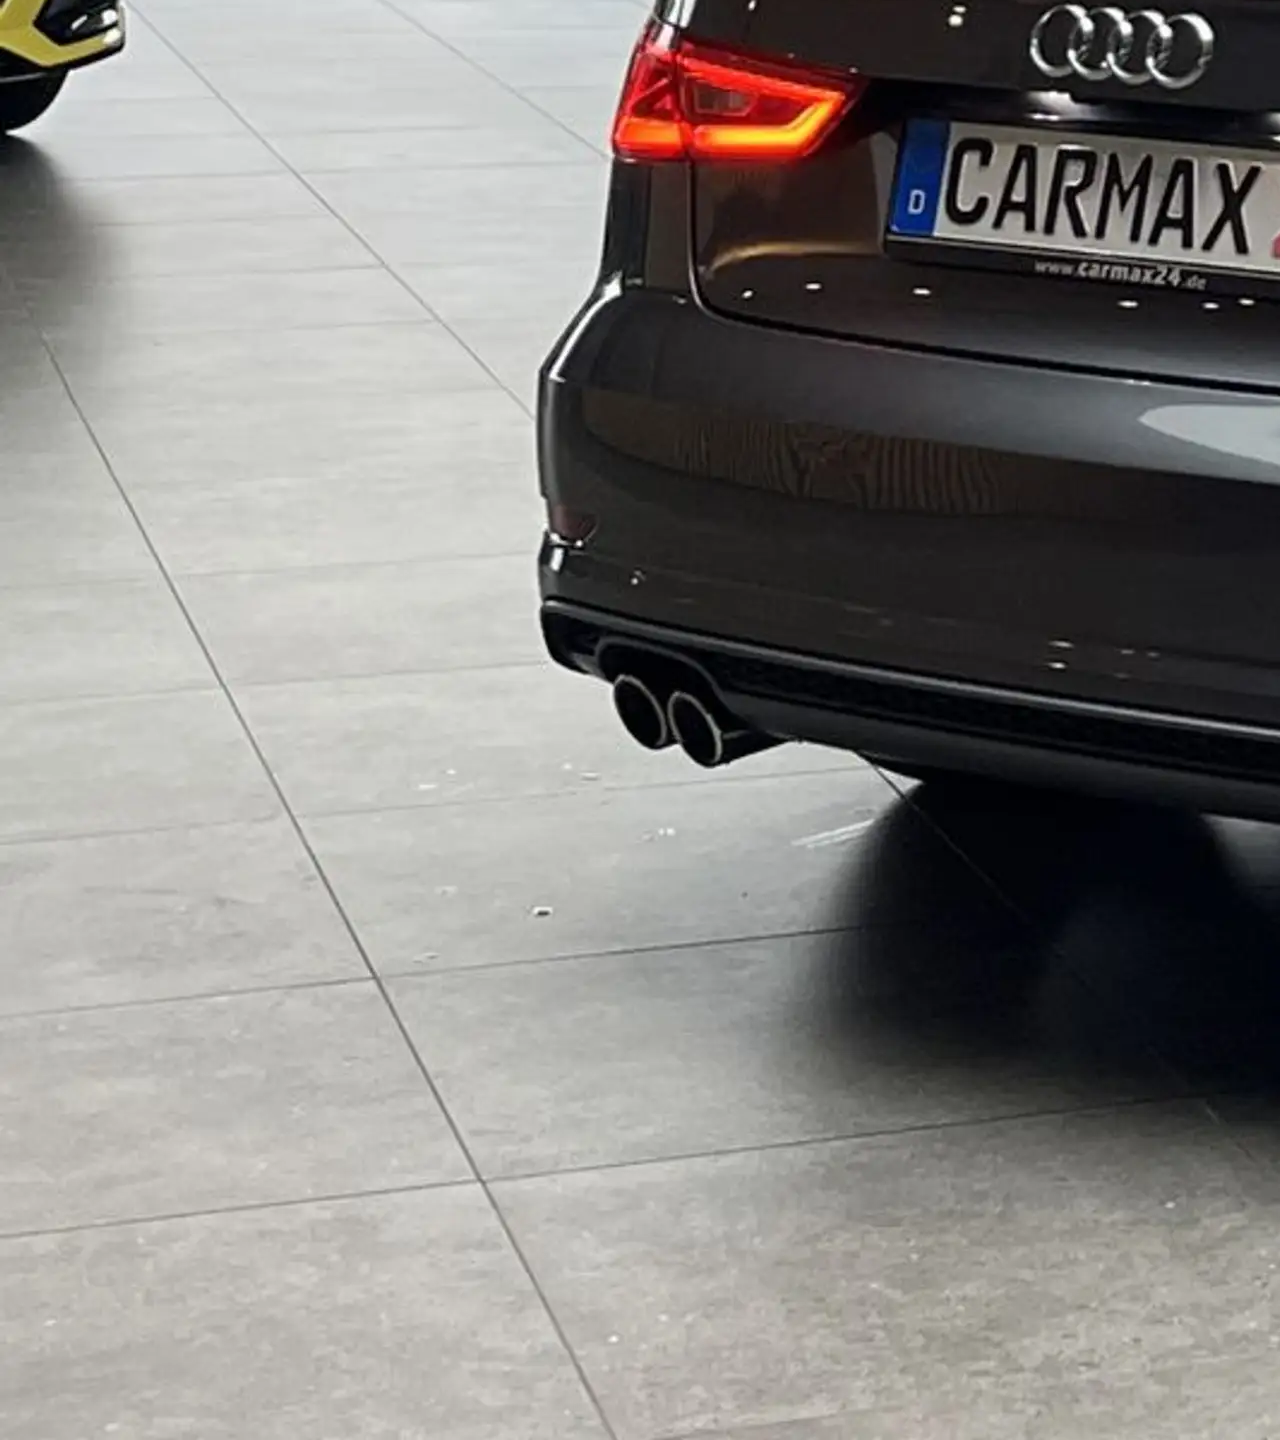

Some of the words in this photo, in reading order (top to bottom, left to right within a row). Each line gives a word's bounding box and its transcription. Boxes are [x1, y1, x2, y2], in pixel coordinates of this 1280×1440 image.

[907, 189, 926, 216] D
[945, 137, 1262, 256] CARMAX
[1034, 261, 1207, 291] www.carmax24.de
